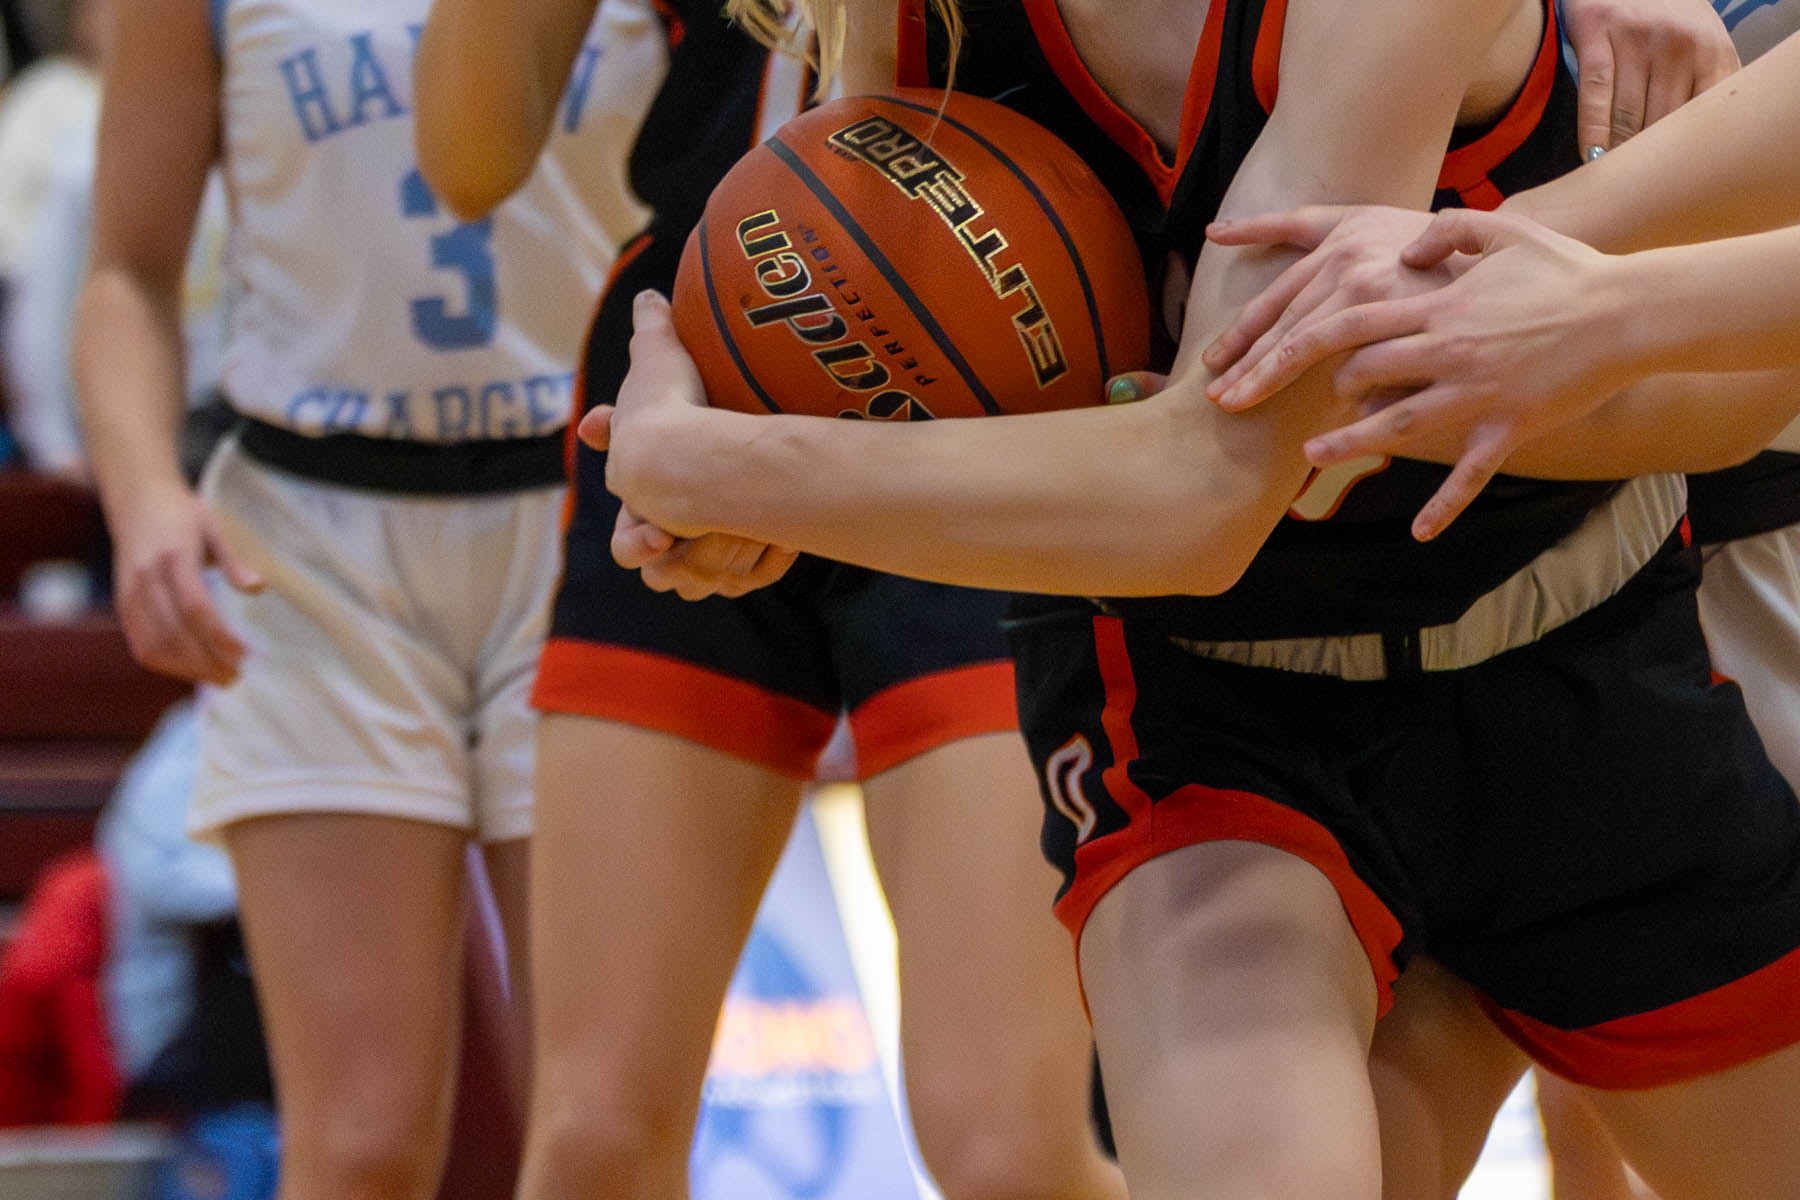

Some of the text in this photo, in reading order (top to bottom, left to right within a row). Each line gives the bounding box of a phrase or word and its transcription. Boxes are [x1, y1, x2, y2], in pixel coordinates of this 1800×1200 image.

[401, 167, 497, 351] 3
[802, 224, 936, 388] PERFECTION
[841, 117, 1069, 389] ELITE PRO
